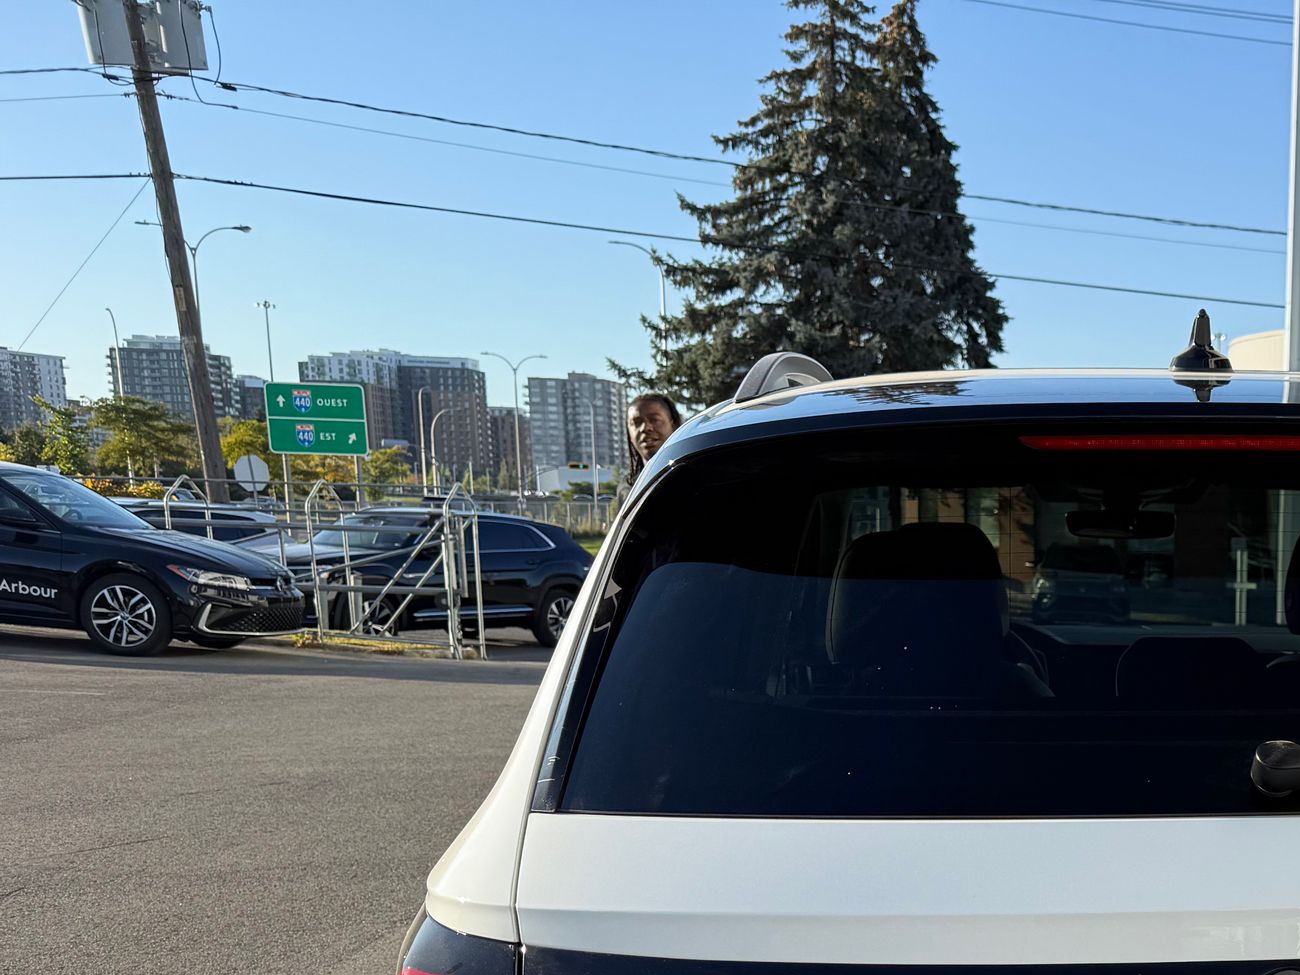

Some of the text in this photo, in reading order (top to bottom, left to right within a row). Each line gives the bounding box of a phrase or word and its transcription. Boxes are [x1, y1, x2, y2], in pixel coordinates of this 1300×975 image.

[295, 397, 348, 407] 440 OUEST
[298, 431, 336, 441] 440 EST
[0, 579, 58, 599] Arbour
